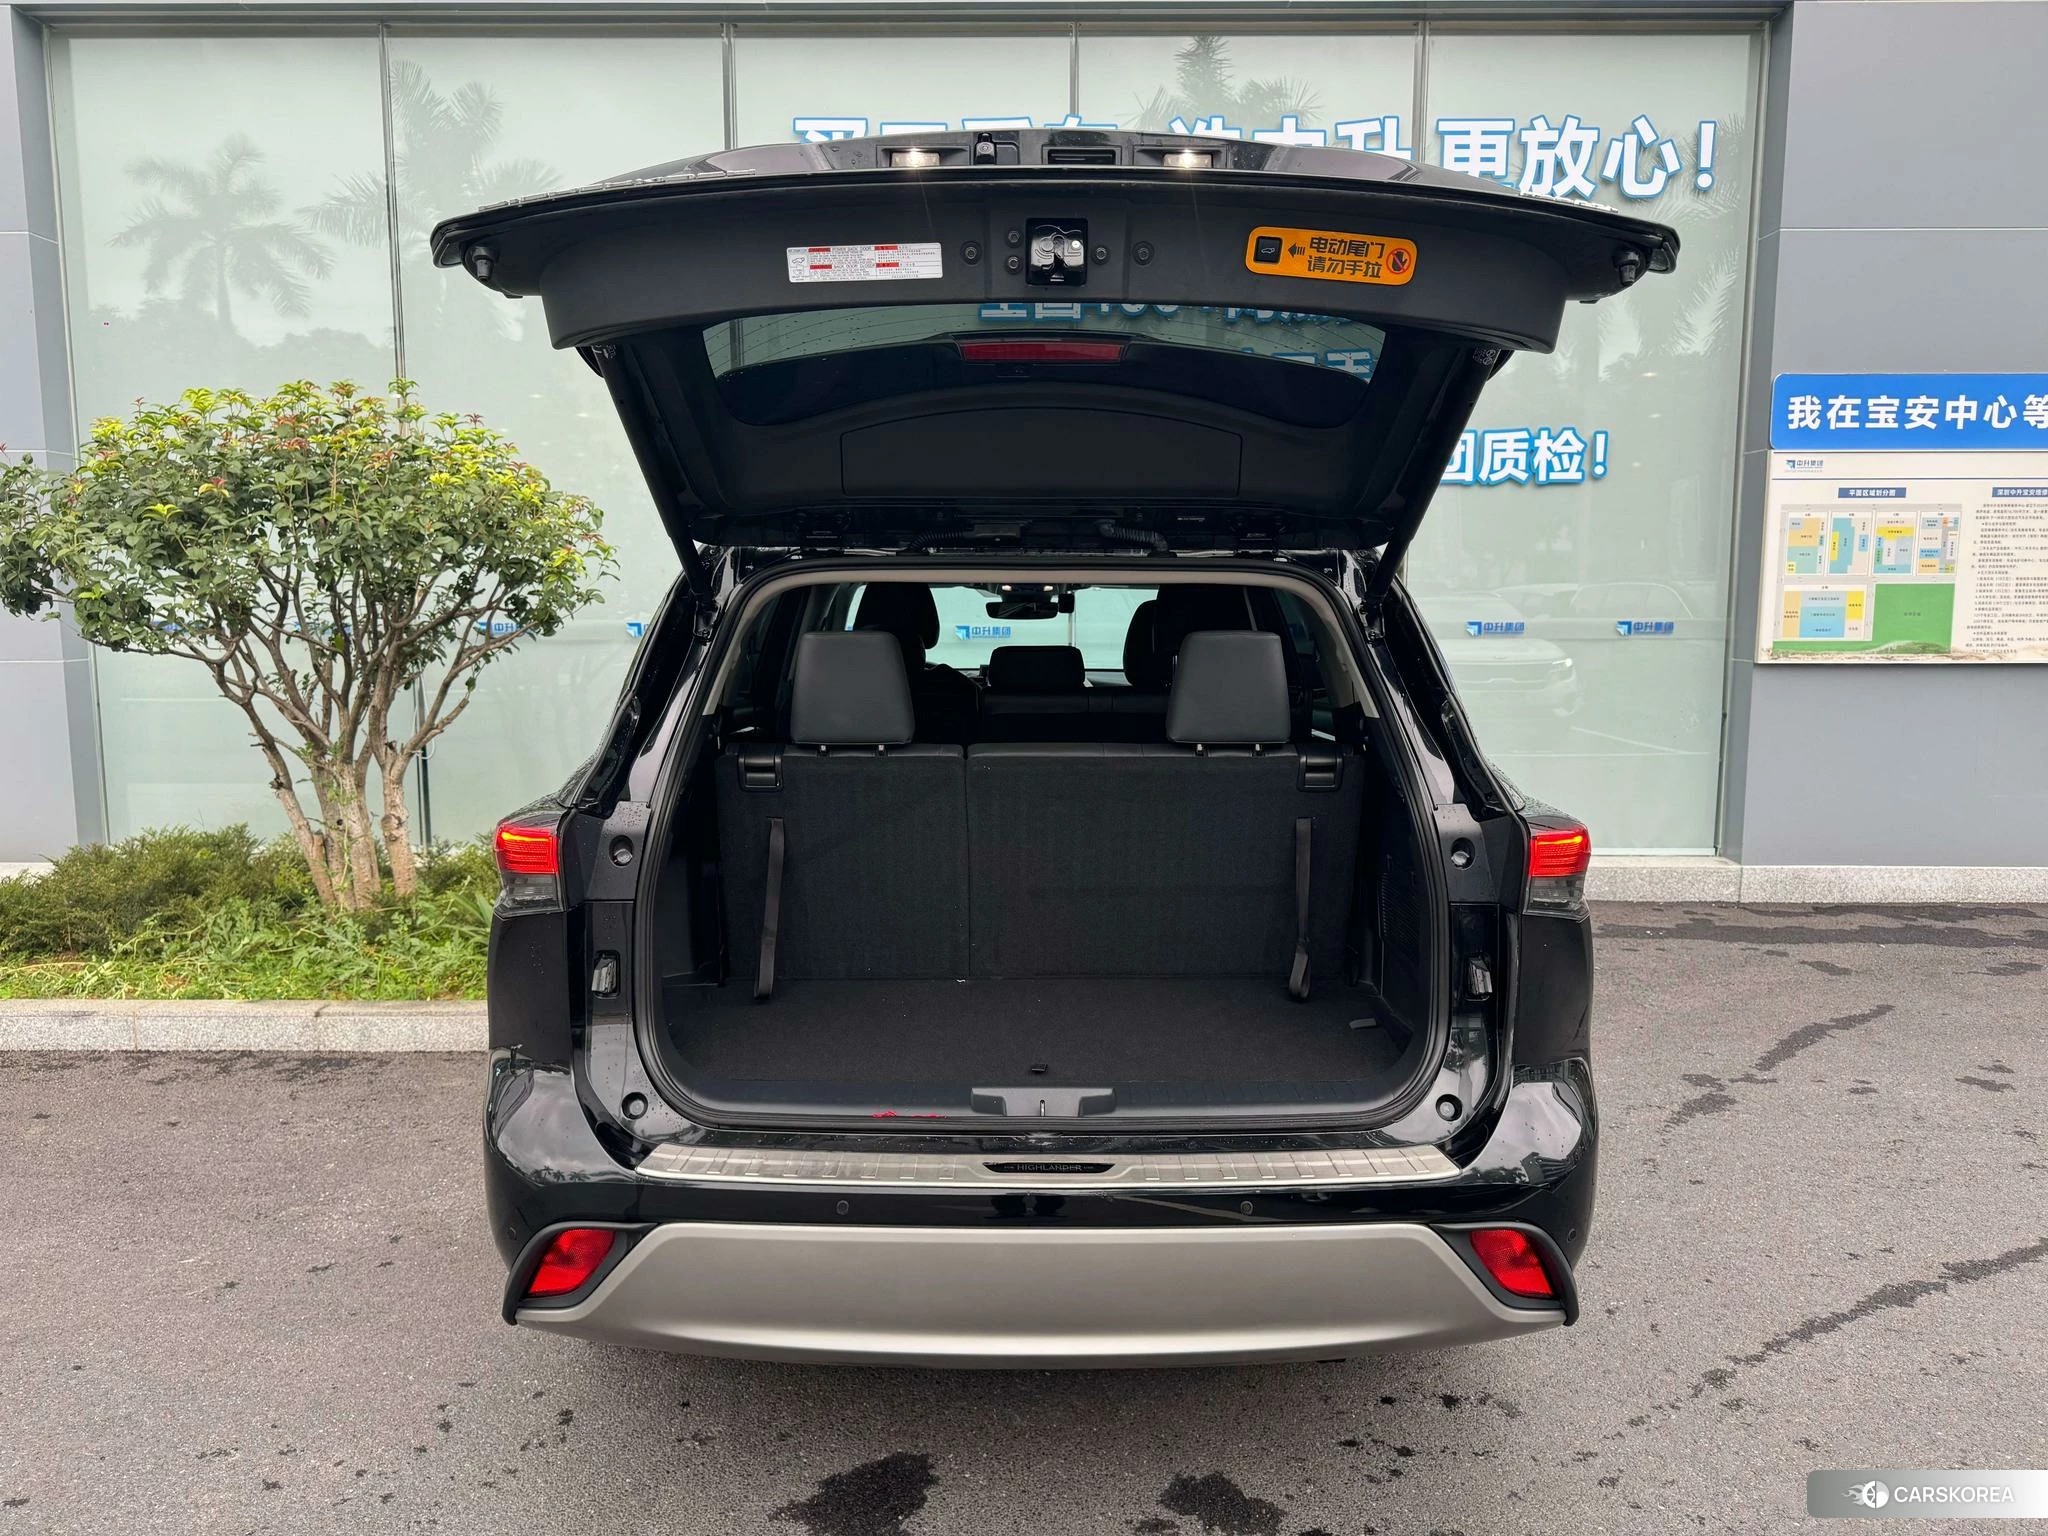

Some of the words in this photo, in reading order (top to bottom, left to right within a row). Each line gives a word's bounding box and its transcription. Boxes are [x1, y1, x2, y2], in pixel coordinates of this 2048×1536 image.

[1309, 237, 1386, 259] 电动尾门
[1307, 255, 1383, 279] 请勿手拉
[1787, 394, 2048, 431] 我在宝安中心等
[971, 626, 1012, 636] 中升集团
[1483, 622, 1526, 633] 中升集团
[1633, 622, 1675, 633] 中升集团
